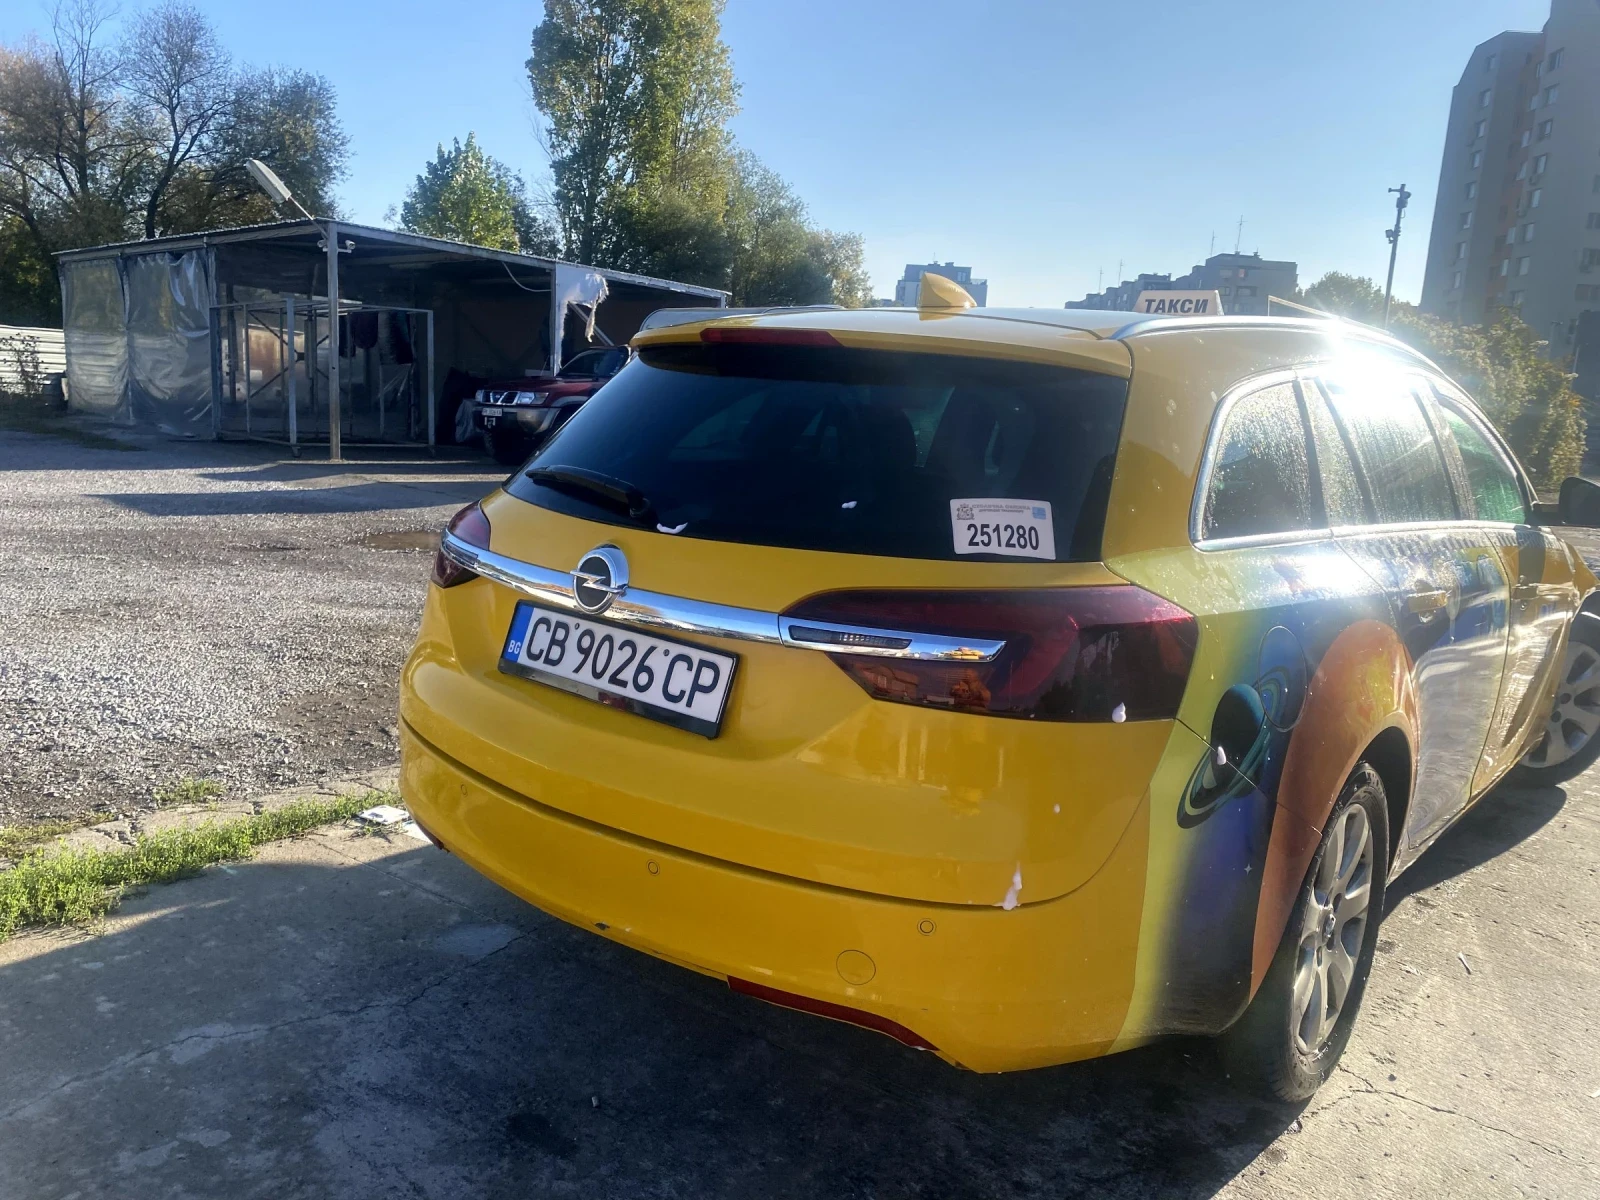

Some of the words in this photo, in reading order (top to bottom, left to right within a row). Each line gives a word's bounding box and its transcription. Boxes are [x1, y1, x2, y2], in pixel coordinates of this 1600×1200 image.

[1145, 299, 1208, 313] ТАКСИ
[967, 523, 1040, 550] 251280
[508, 640, 521, 654] BG
